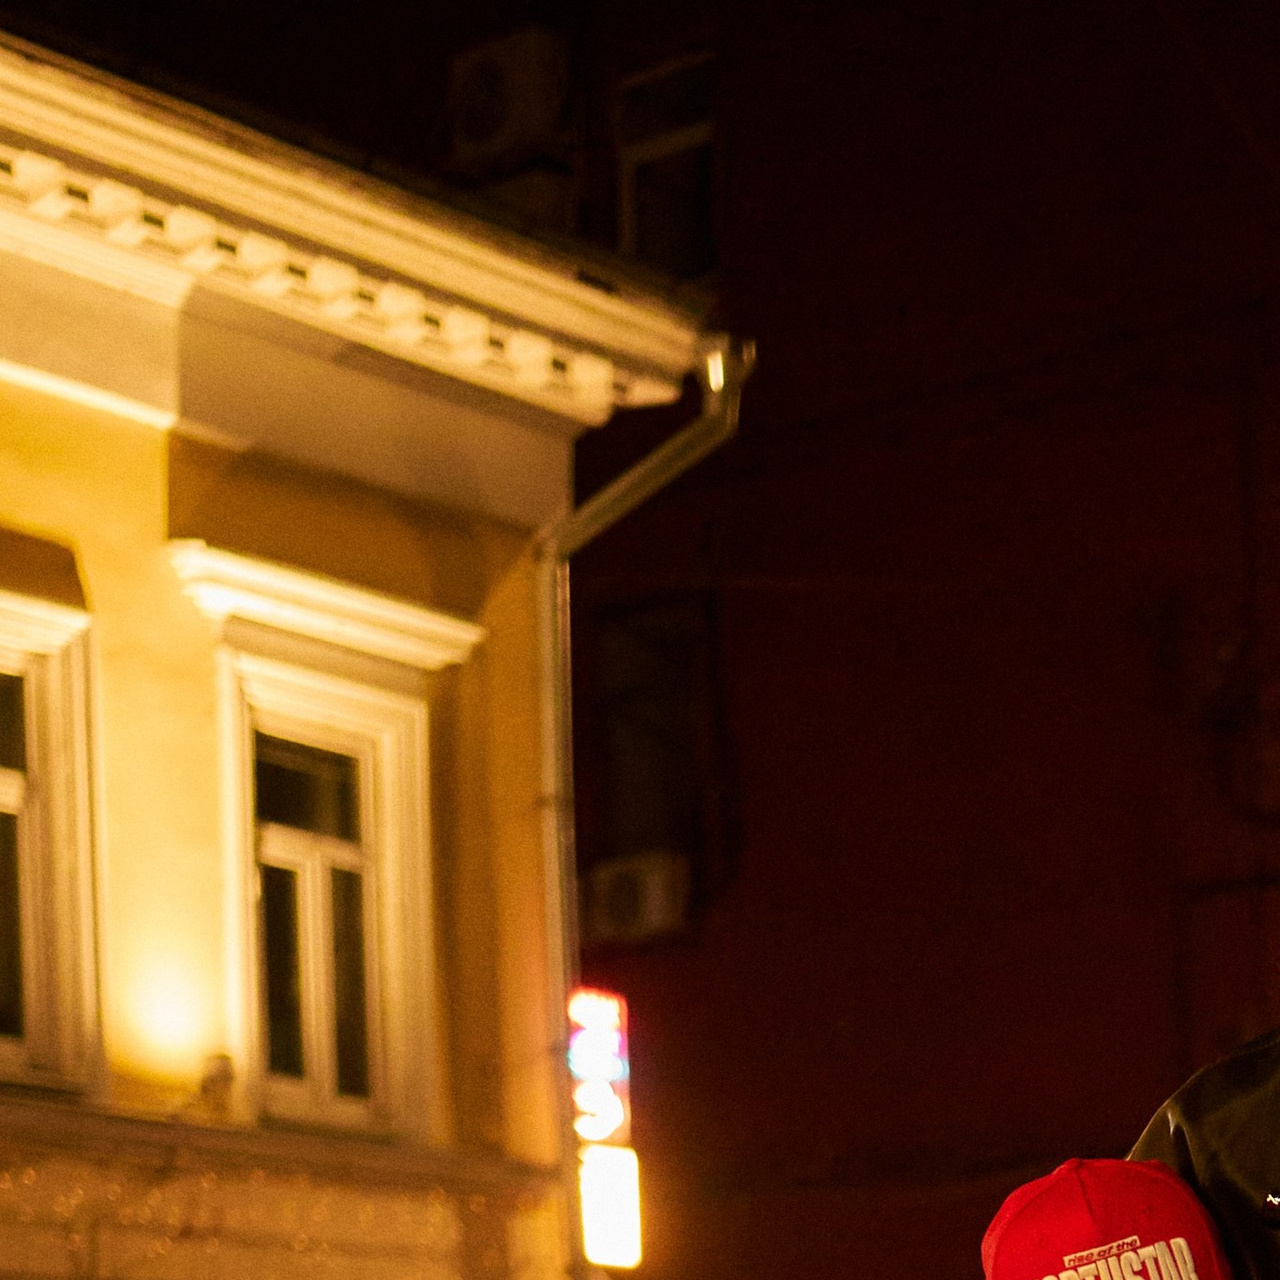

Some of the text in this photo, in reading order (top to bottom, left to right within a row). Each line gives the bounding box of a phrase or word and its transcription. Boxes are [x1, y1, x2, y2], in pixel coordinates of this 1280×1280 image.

[1068, 1238, 1138, 1266] rise of the
